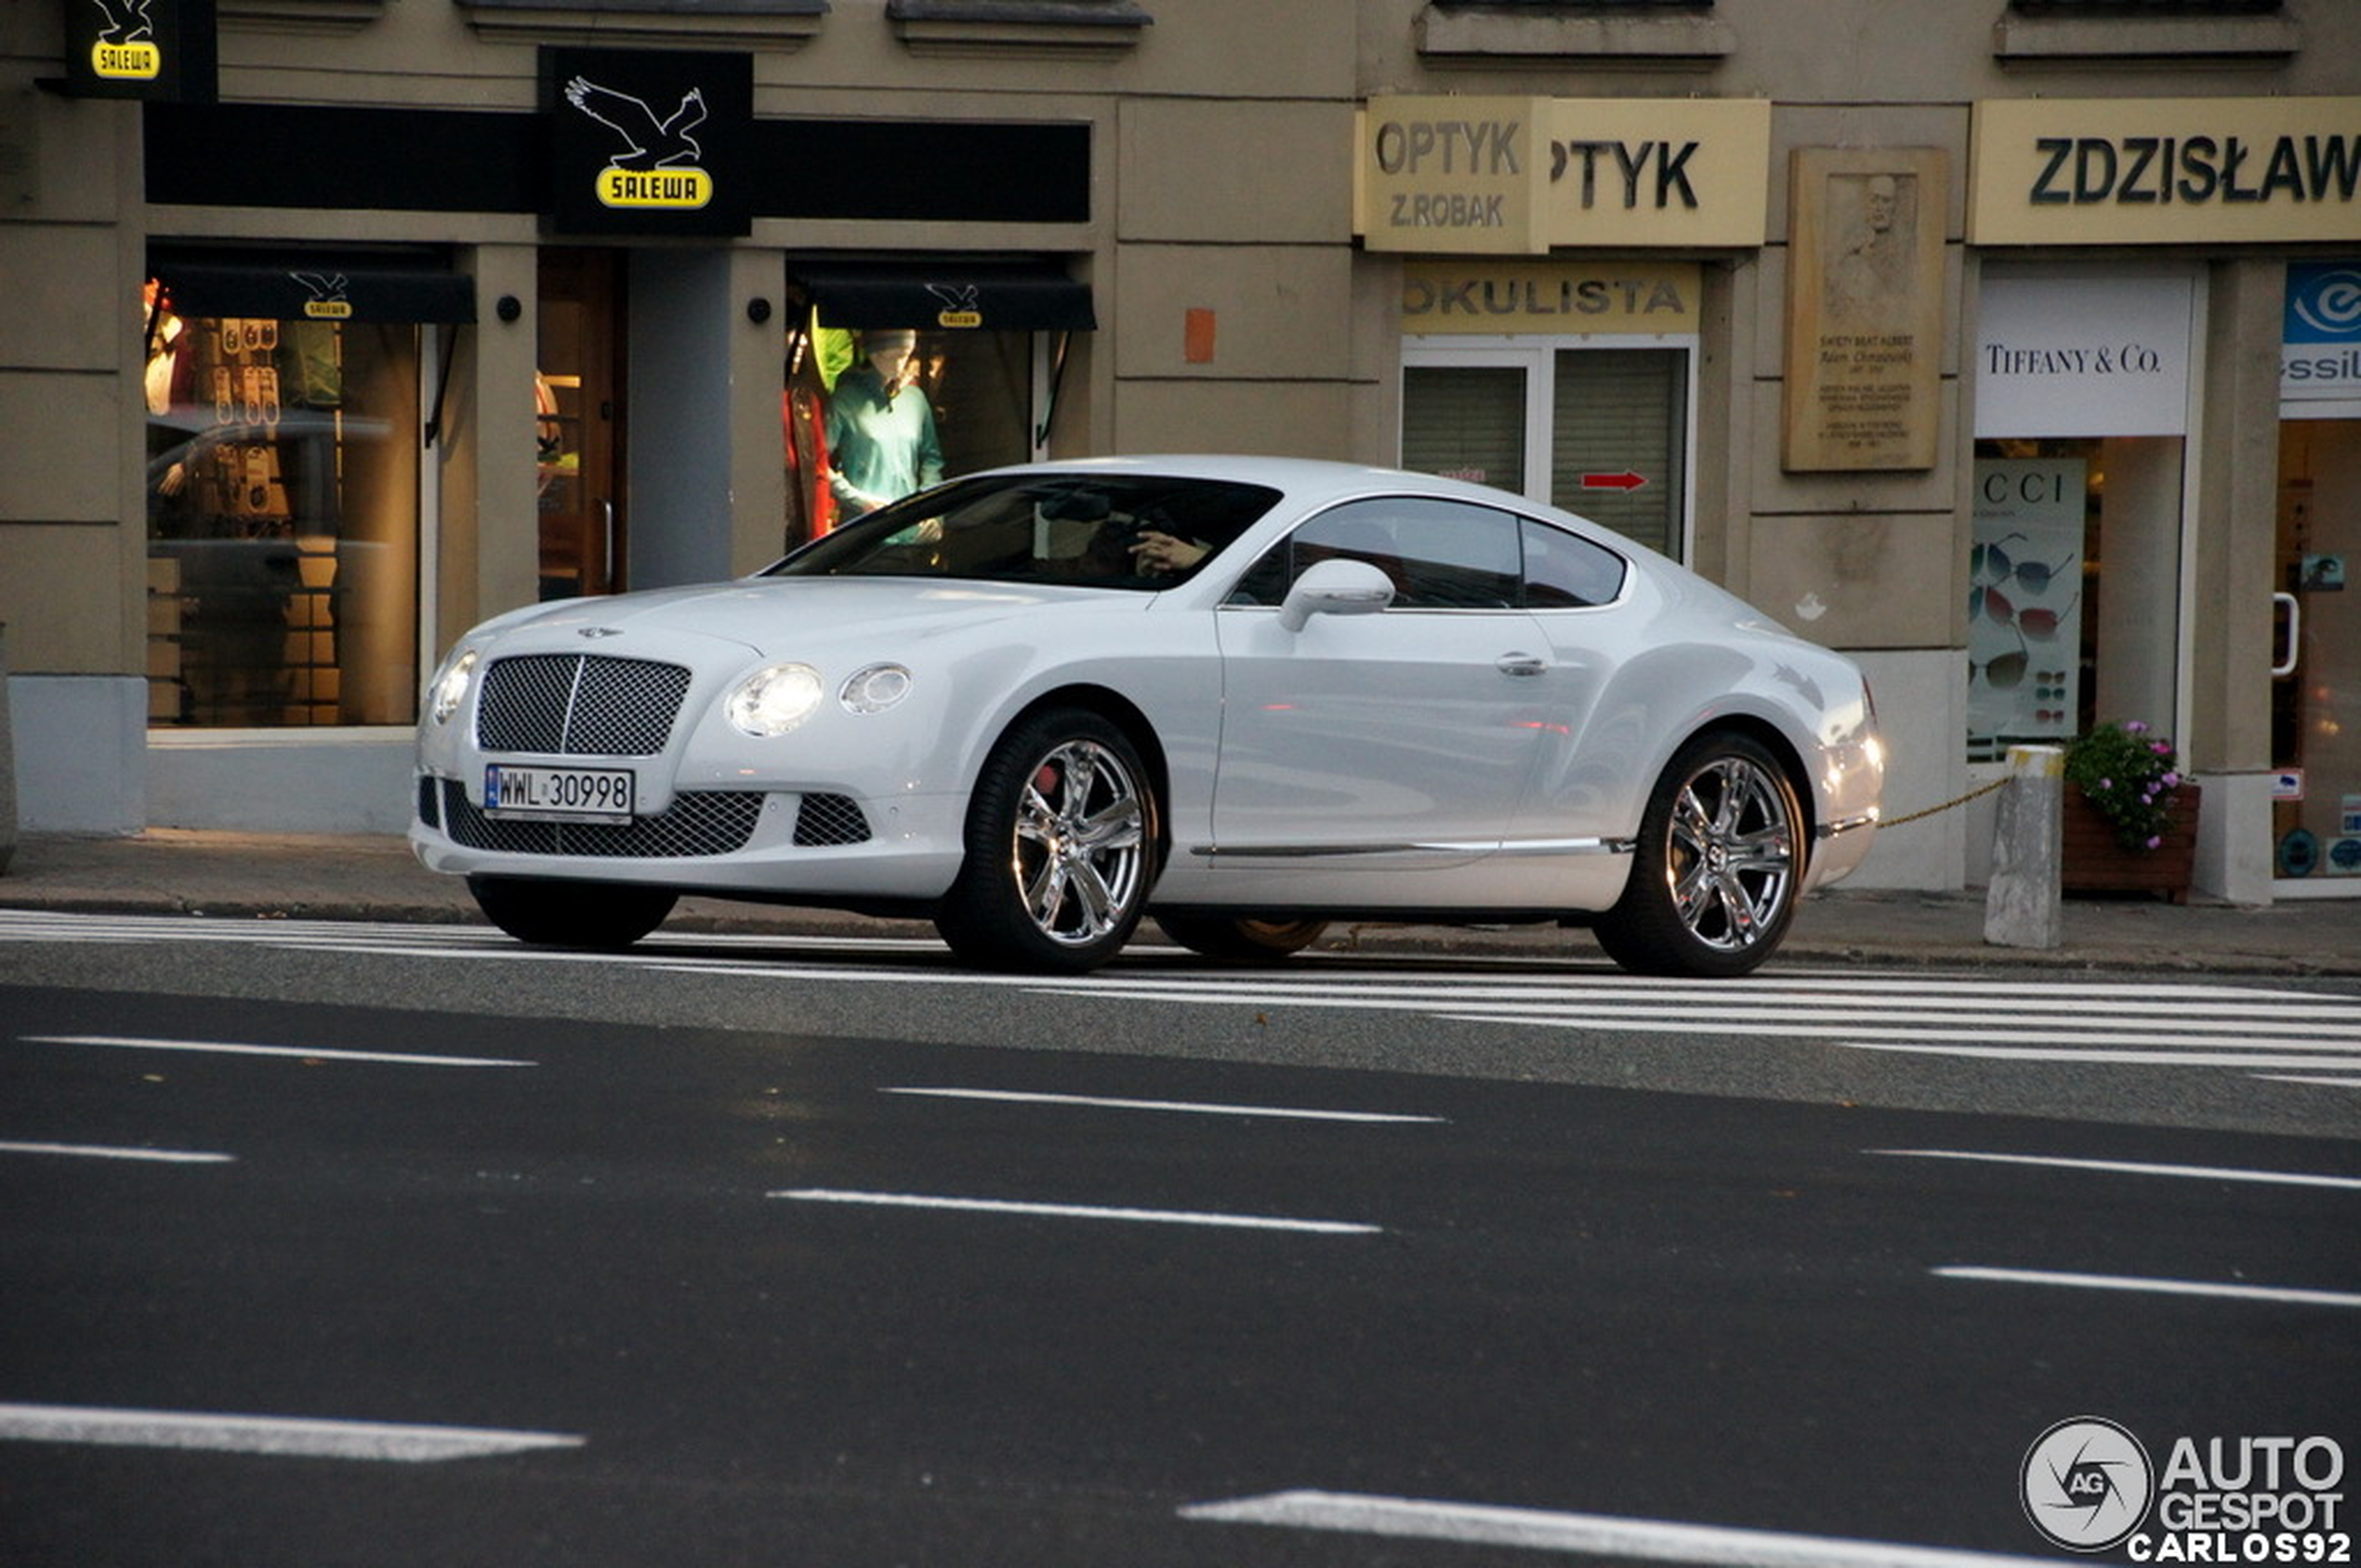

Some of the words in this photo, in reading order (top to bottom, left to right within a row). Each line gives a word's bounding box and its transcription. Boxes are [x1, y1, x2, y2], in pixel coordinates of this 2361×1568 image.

[100, 49, 152, 70] SALEWA
[1376, 121, 1519, 175] OPTYK
[2029, 136, 2361, 205] ZDZISŁAW
[612, 177, 697, 199] SALEWA
[1391, 194, 1503, 227] Z.ROBAK
[2095, 345, 2113, 374] &
[499, 771, 541, 806] WWL
[549, 773, 627, 809] 30998
